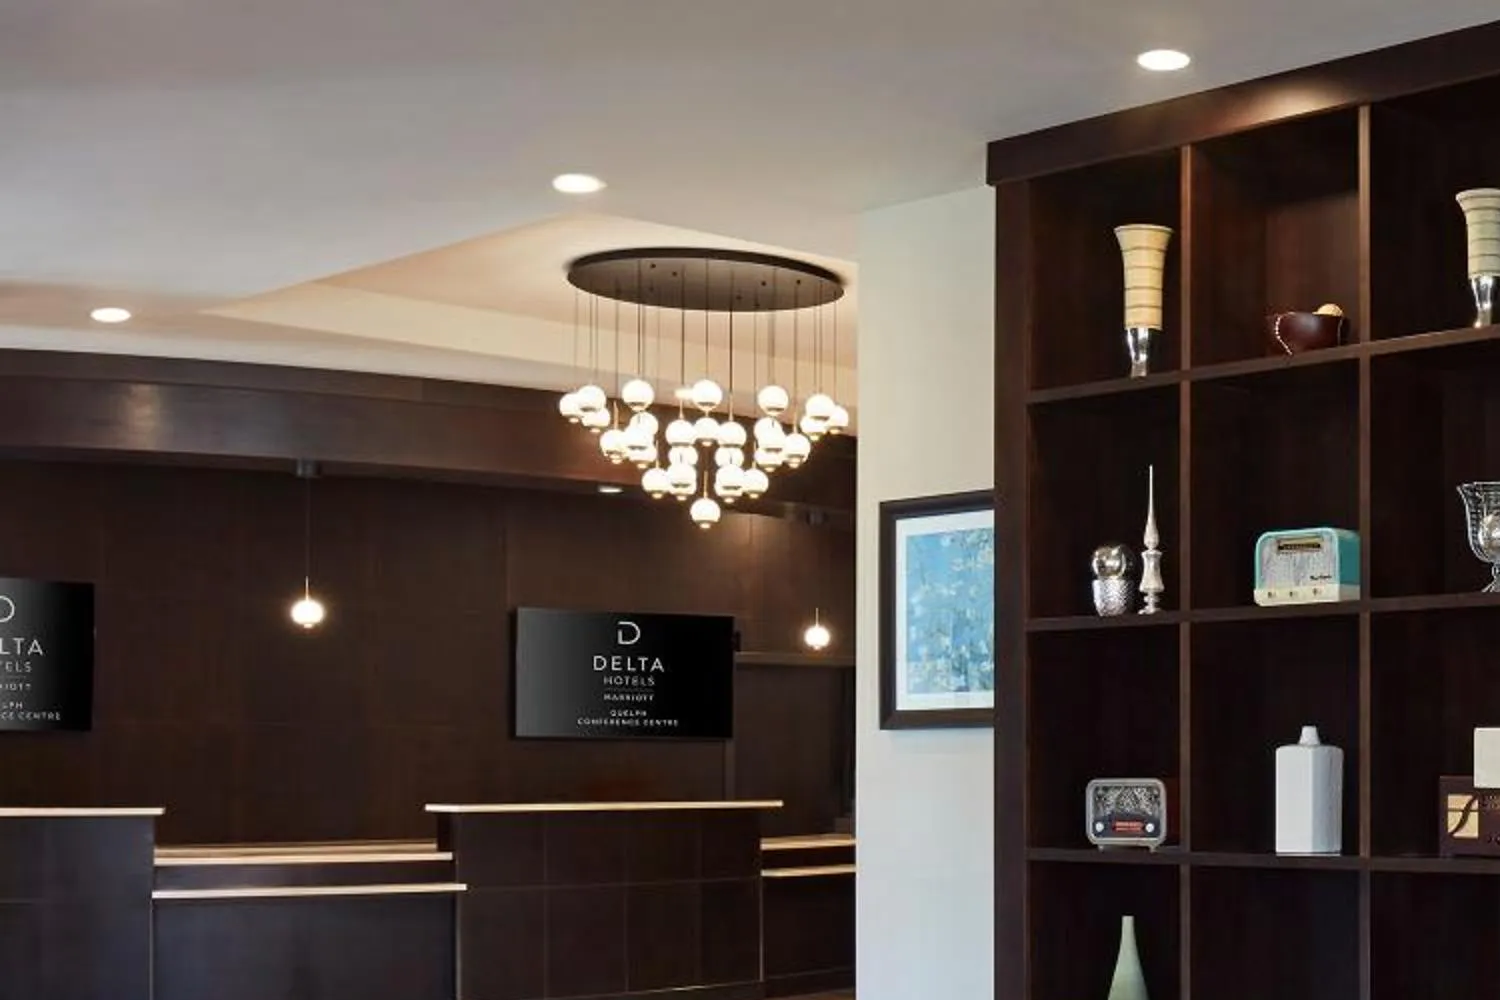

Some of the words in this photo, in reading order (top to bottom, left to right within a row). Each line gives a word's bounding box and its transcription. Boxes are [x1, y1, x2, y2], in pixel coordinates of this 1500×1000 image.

[0, 637, 44, 656] LTA
[0, 661, 33, 673] ELS
[592, 655, 665, 673] DELTA
[603, 675, 656, 687] HOTELS
